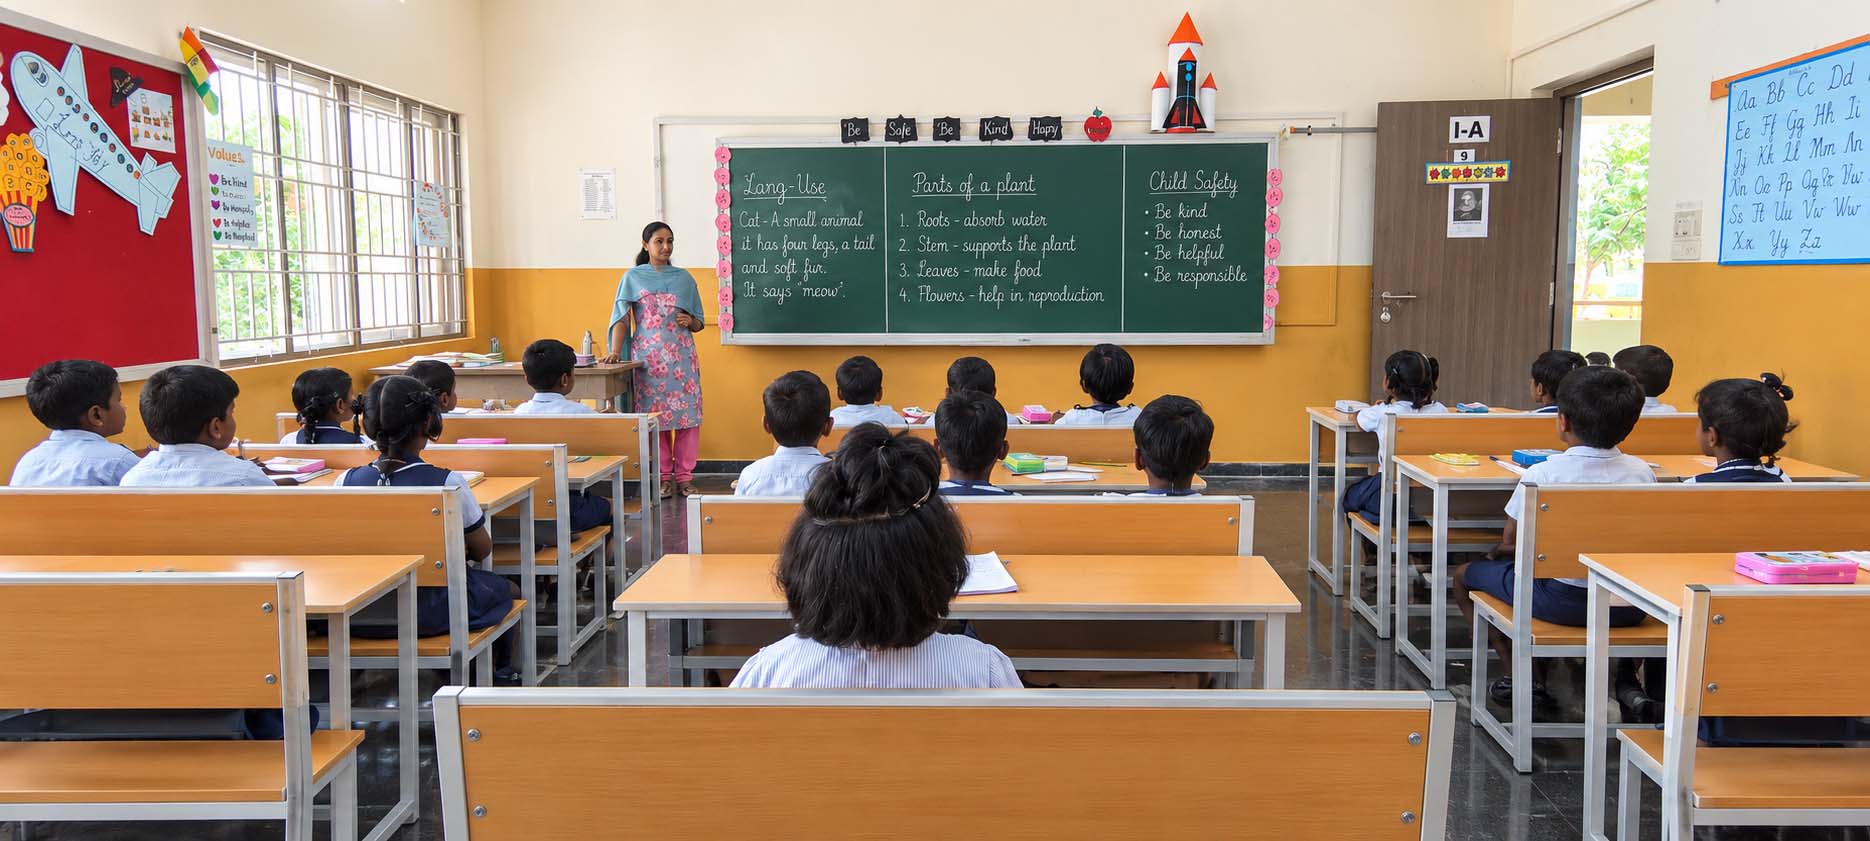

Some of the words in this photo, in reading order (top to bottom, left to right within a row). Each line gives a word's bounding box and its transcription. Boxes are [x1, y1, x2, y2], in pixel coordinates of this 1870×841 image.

[1766, 78, 1785, 104] Bb
[1796, 72, 1815, 97] Cc
[1827, 60, 1855, 91] Dd
[847, 122, 861, 137] Be
[984, 121, 1008, 136] Kind
[1453, 120, 1484, 139] I-A
[1735, 120, 1751, 141] Ee
[1812, 101, 1835, 127] Hh
[1844, 95, 1861, 120] Ii
[1460, 151, 1468, 161] 9
[1809, 137, 1836, 159] Mm
[743, 172, 827, 206] Lang-Use
[912, 171, 953, 194] Parts
[959, 172, 974, 202] of
[980, 181, 991, 192] a
[996, 172, 1037, 201] plant
[1149, 170, 1187, 191] Child
[1194, 169, 1239, 199] Safety
[1779, 172, 1793, 199] Pp
[739, 210, 760, 228] Cat
[770, 211, 781, 228] A
[783, 210, 817, 228] small
[820, 210, 864, 228] animal
[900, 213, 910, 228] 1.
[917, 209, 950, 228] Roots
[963, 209, 1005, 228] absorb
[1011, 210, 1048, 227] water
[1154, 202, 1172, 219] Be
[1178, 202, 1208, 219] kind
[1729, 204, 1744, 225] Ss
[1775, 201, 1793, 222] Uu
[1833, 195, 1862, 217] Ww
[1154, 223, 1172, 240] Be
[1178, 222, 1223, 240] honest
[1732, 230, 1754, 251] Xx
[1769, 229, 1789, 258] Yy
[740, 235, 752, 251] it
[757, 233, 778, 251] has
[782, 234, 808, 258] four
[812, 234, 839, 258] legs,
[841, 241, 851, 250] a
[853, 233, 876, 251] tail
[899, 238, 910, 252] 2.
[917, 235, 950, 252] Stem
[962, 235, 1013, 259] supports
[1018, 234, 1037, 252] the
[1042, 234, 1077, 259] plant
[1154, 243, 1172, 261] Be
[1178, 243, 1225, 267] helpful
[741, 258, 768, 274] and
[774, 258, 798, 282] soft
[803, 257, 827, 282] fur.
[899, 263, 910, 278] 3.
[917, 259, 959, 278] Leaves
[974, 260, 1008, 277] make
[1013, 259, 1042, 284] food
[1153, 265, 1172, 282] Be
[1176, 265, 1248, 290] responsible
[743, 281, 756, 298] It
[762, 287, 792, 305] says
[899, 287, 911, 302] 4.
[918, 285, 965, 302] Flowers
[978, 285, 1005, 310] help
[1010, 287, 1023, 302] in
[1028, 285, 1105, 309] reproduction
